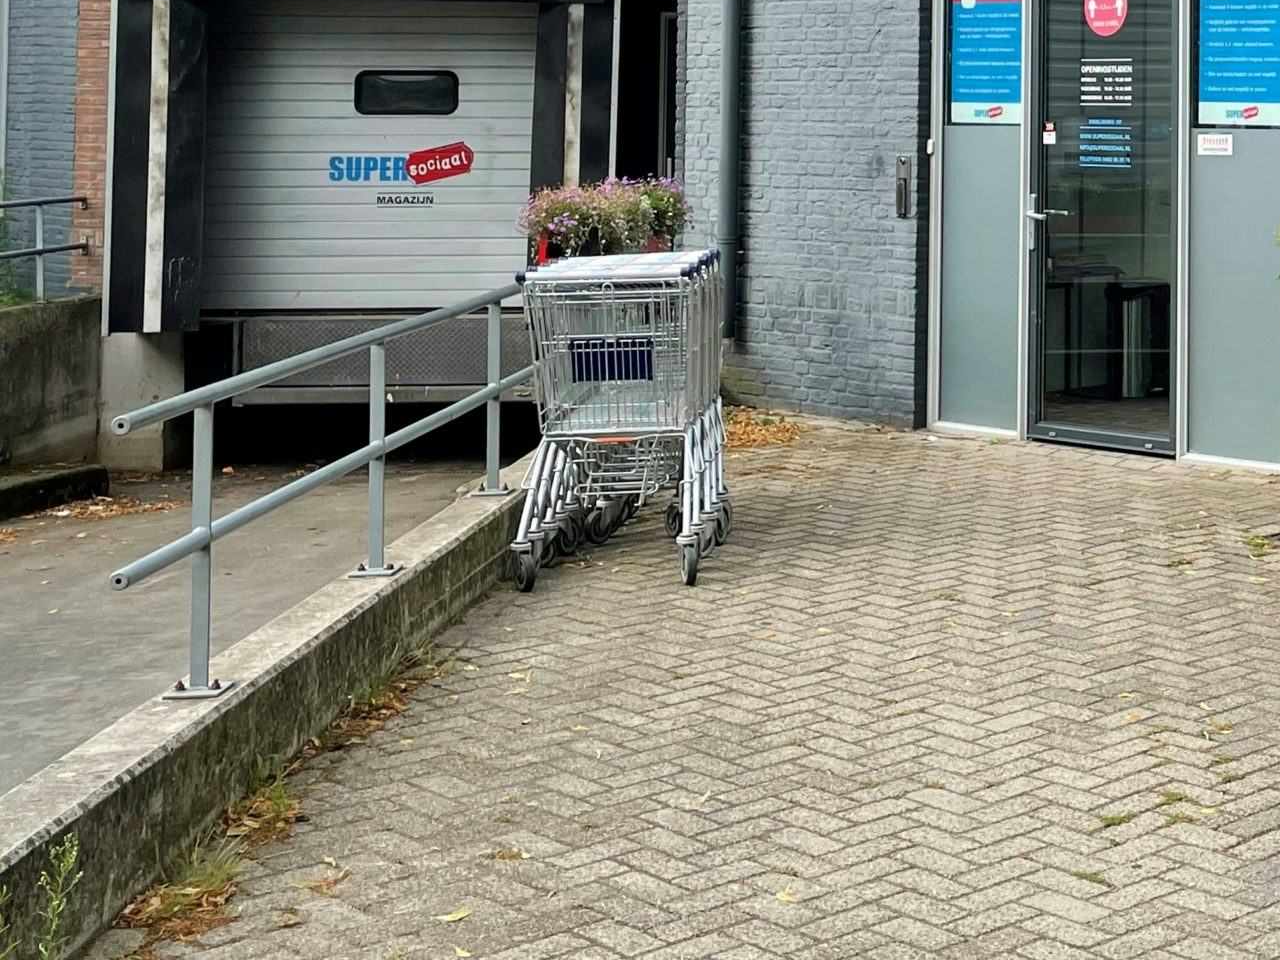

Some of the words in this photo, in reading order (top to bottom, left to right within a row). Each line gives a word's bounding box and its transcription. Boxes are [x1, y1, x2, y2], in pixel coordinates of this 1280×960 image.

[329, 156, 408, 182] SUPER
[408, 151, 468, 177] sociaal
[376, 195, 434, 205] MAGAZIJN
